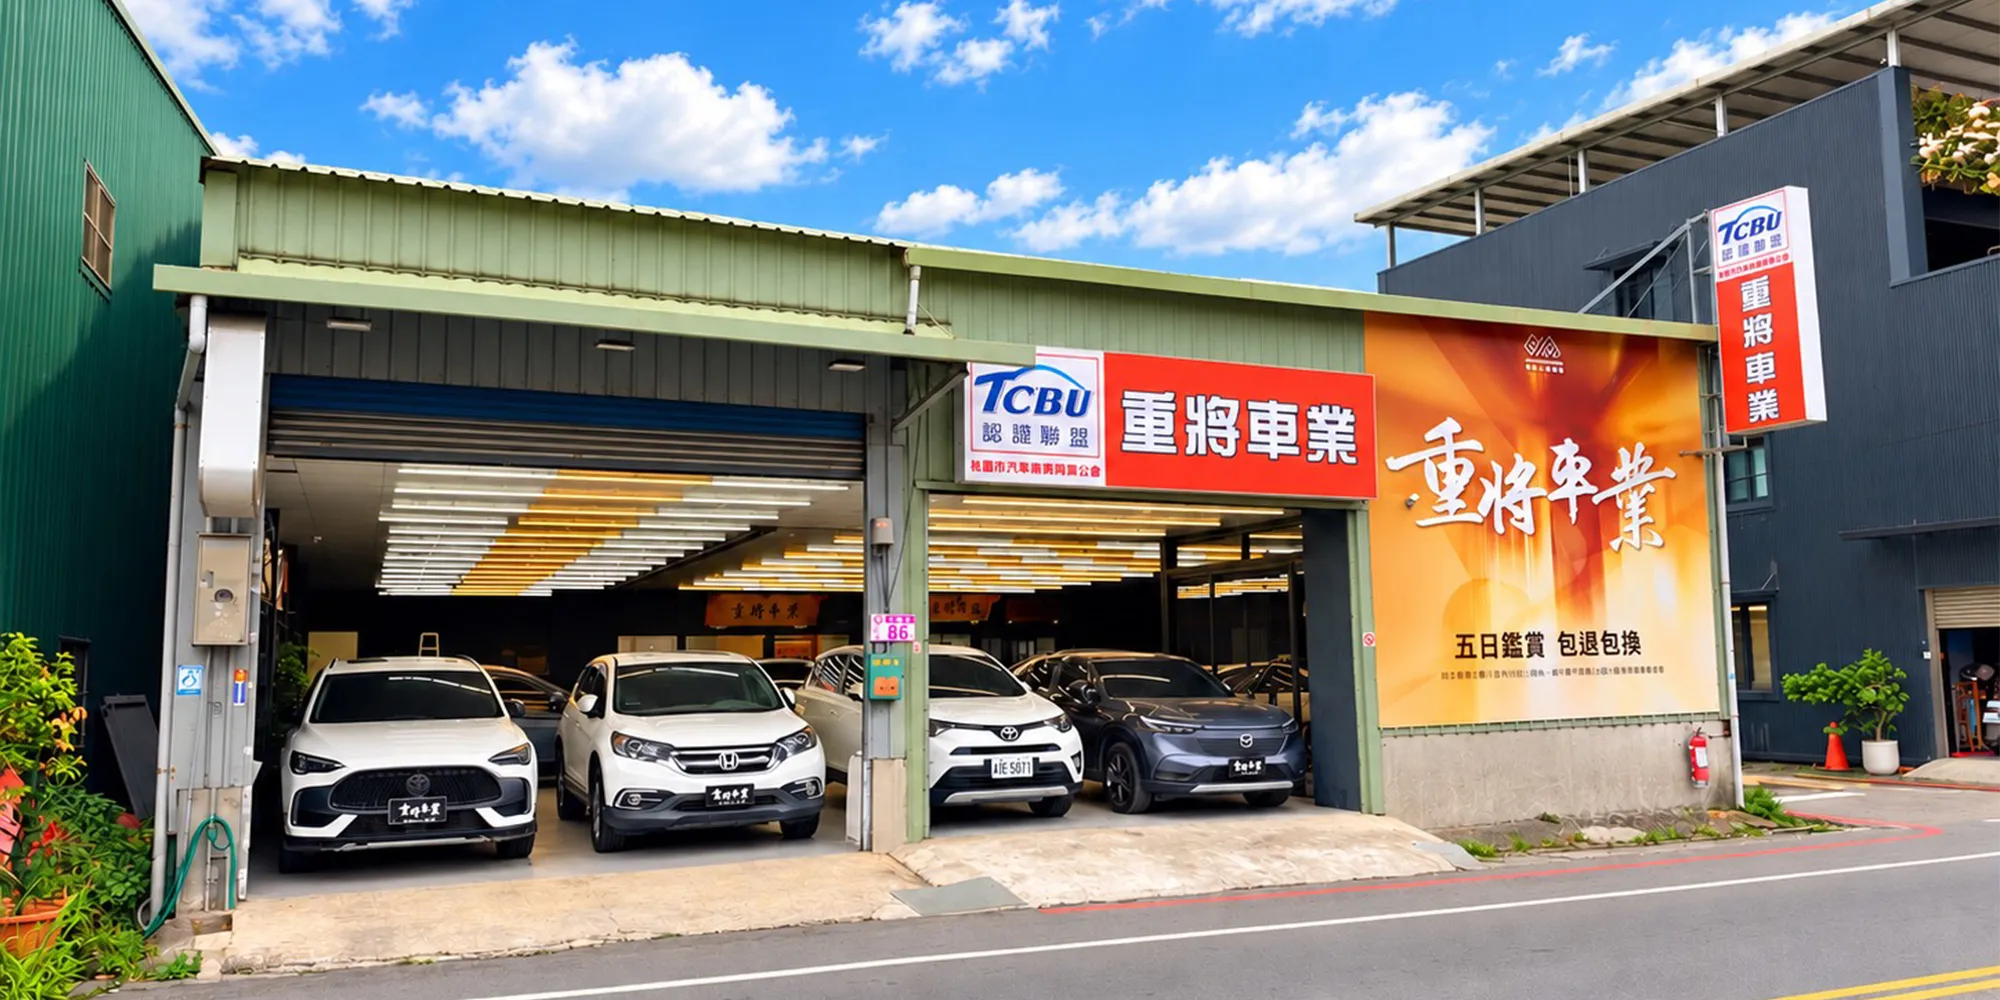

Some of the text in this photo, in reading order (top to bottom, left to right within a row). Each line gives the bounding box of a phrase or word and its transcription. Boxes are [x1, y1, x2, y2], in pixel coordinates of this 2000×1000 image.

[1717, 206, 1782, 246] TCBU
[1740, 275, 1780, 423] 重將車業
[974, 365, 1095, 417] TCBU
[1120, 389, 1359, 466] 重將車業
[1386, 417, 1677, 552] 重將車業
[888, 624, 908, 640] 86
[1455, 630, 1642, 660] 五日鑑賞 包退包換
